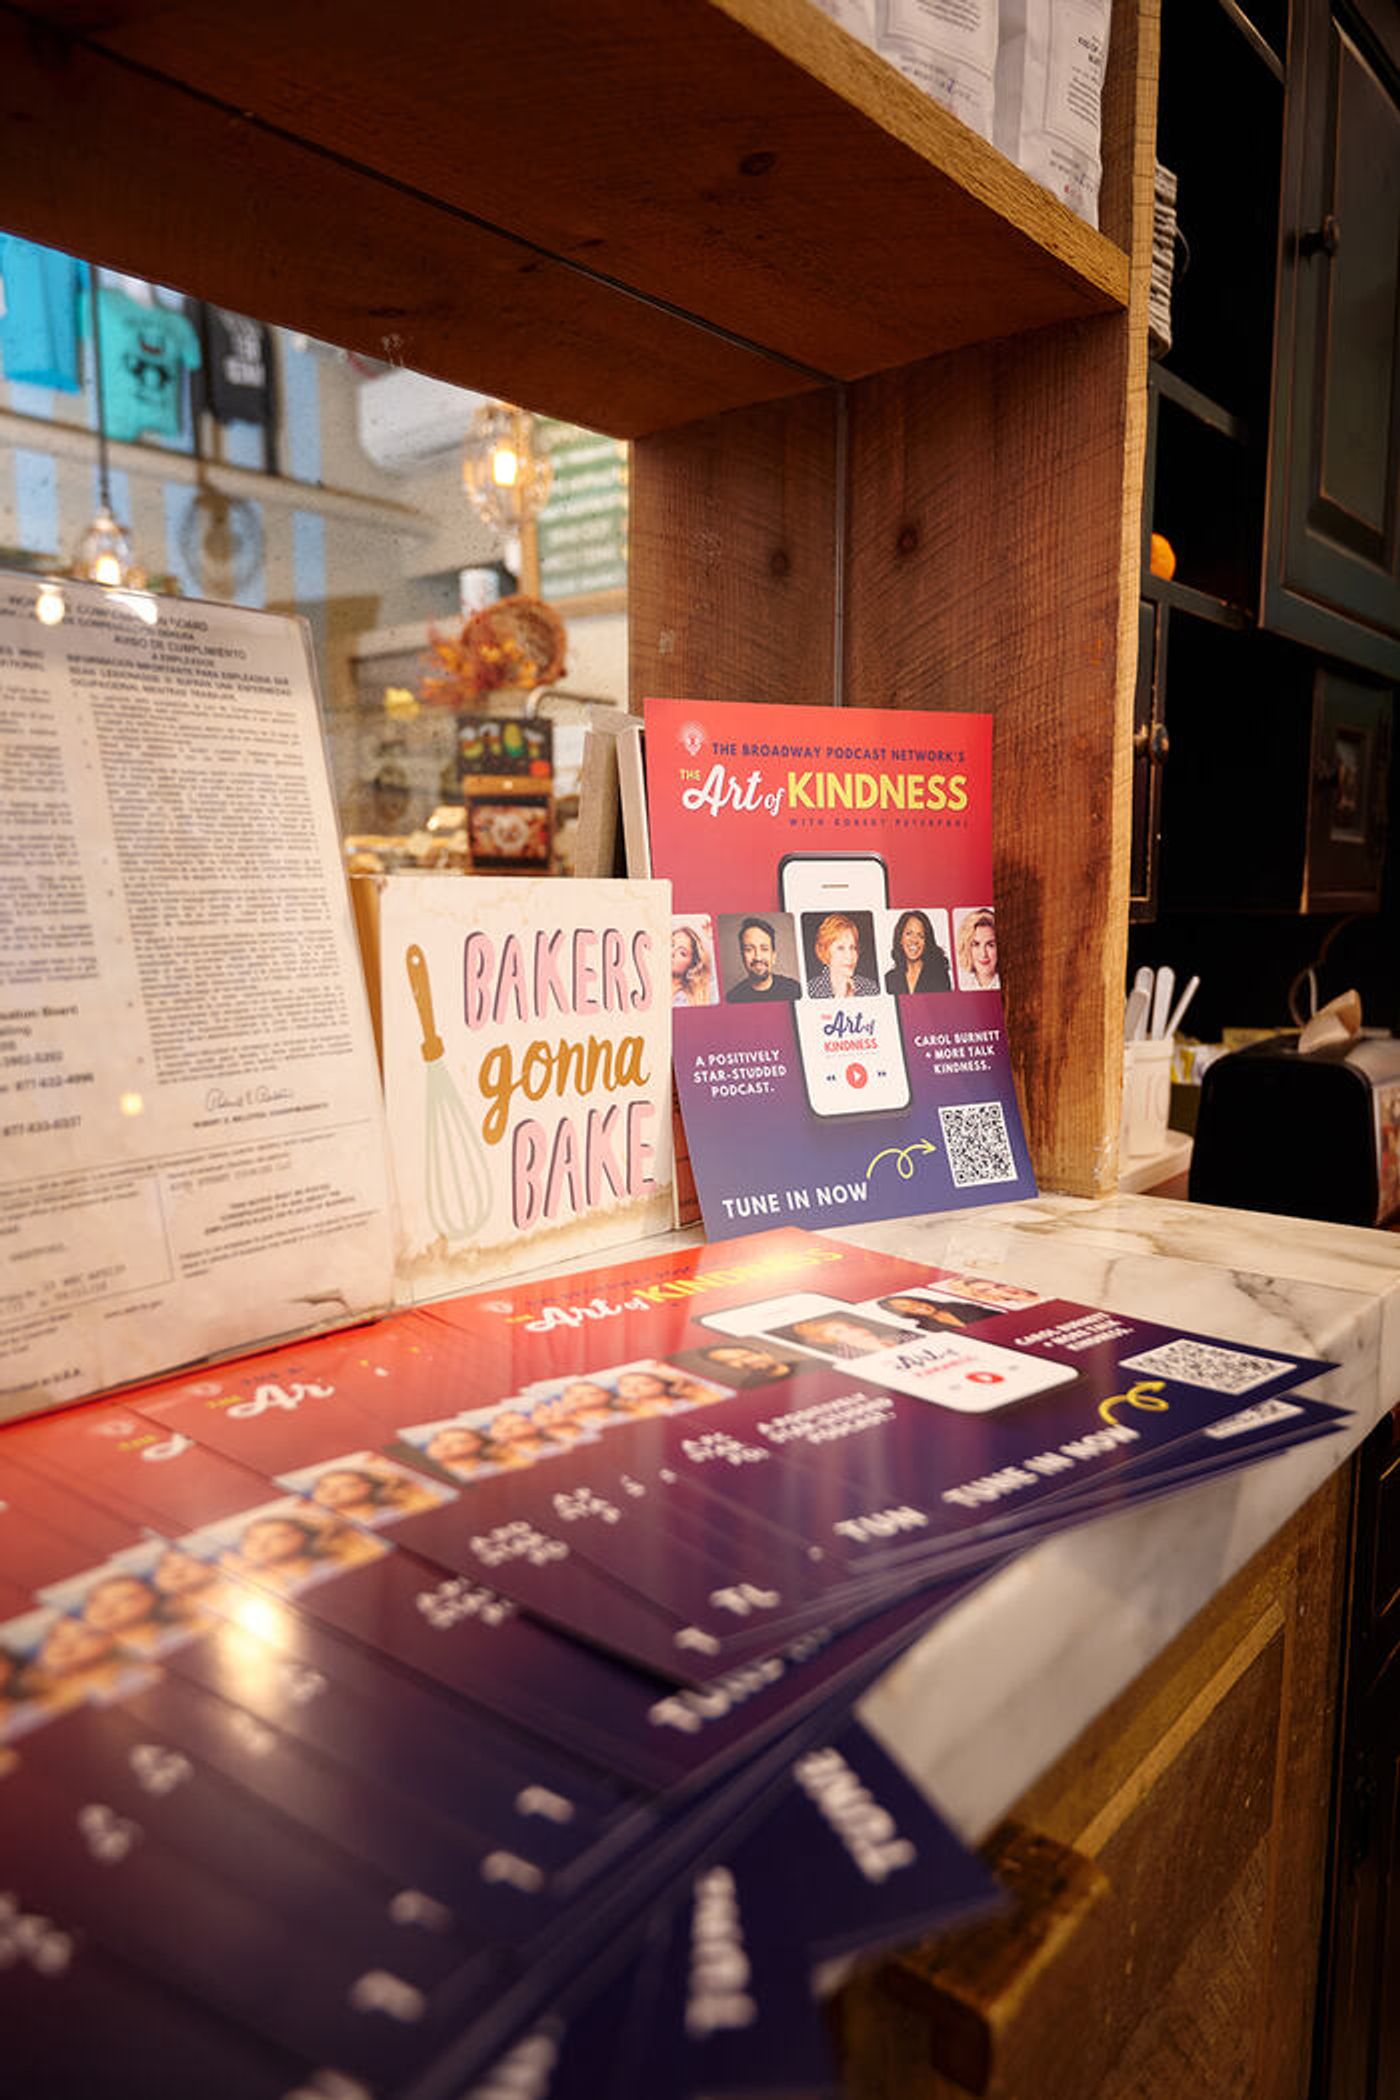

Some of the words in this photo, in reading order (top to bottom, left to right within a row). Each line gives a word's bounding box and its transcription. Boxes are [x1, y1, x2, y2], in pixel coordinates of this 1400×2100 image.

[712, 742, 737, 756] THE
[741, 743, 821, 758] BROADWAY
[826, 746, 887, 761] PODCAST
[891, 749, 966, 763] NETWORK'S
[679, 768, 701, 781] THE
[681, 763, 764, 817] Art
[764, 787, 786, 816] of
[787, 771, 969, 812] KINDNESS
[463, 926, 654, 1032] BAKERS
[823, 1010, 863, 1038] Art
[914, 1032, 951, 1047] CAROL
[954, 1029, 1001, 1044] BURNETT
[695, 1055, 706, 1067] A
[708, 1049, 780, 1067] POSITIVELY
[824, 1038, 879, 1053] KINDNESS
[934, 1047, 966, 1060] MORE
[968, 1045, 996, 1058] TALK
[693, 1065, 788, 1084] STAR-STUDDED
[933, 1060, 993, 1075] KINDNESS.
[477, 1034, 652, 1146] gonna
[711, 1082, 776, 1098] PODCAST.
[511, 1099, 658, 1232] BAKE
[721, 1193, 782, 1219] TUNE
[785, 1187, 813, 1211] IN
[816, 1181, 869, 1207] NOW
[524, 1298, 625, 1333] Art
[632, 1246, 846, 1304] KINDNESS
[941, 1465, 1039, 1508] TUNE
[1023, 1451, 1076, 1477] IN
[1058, 1423, 1141, 1461] NOW
